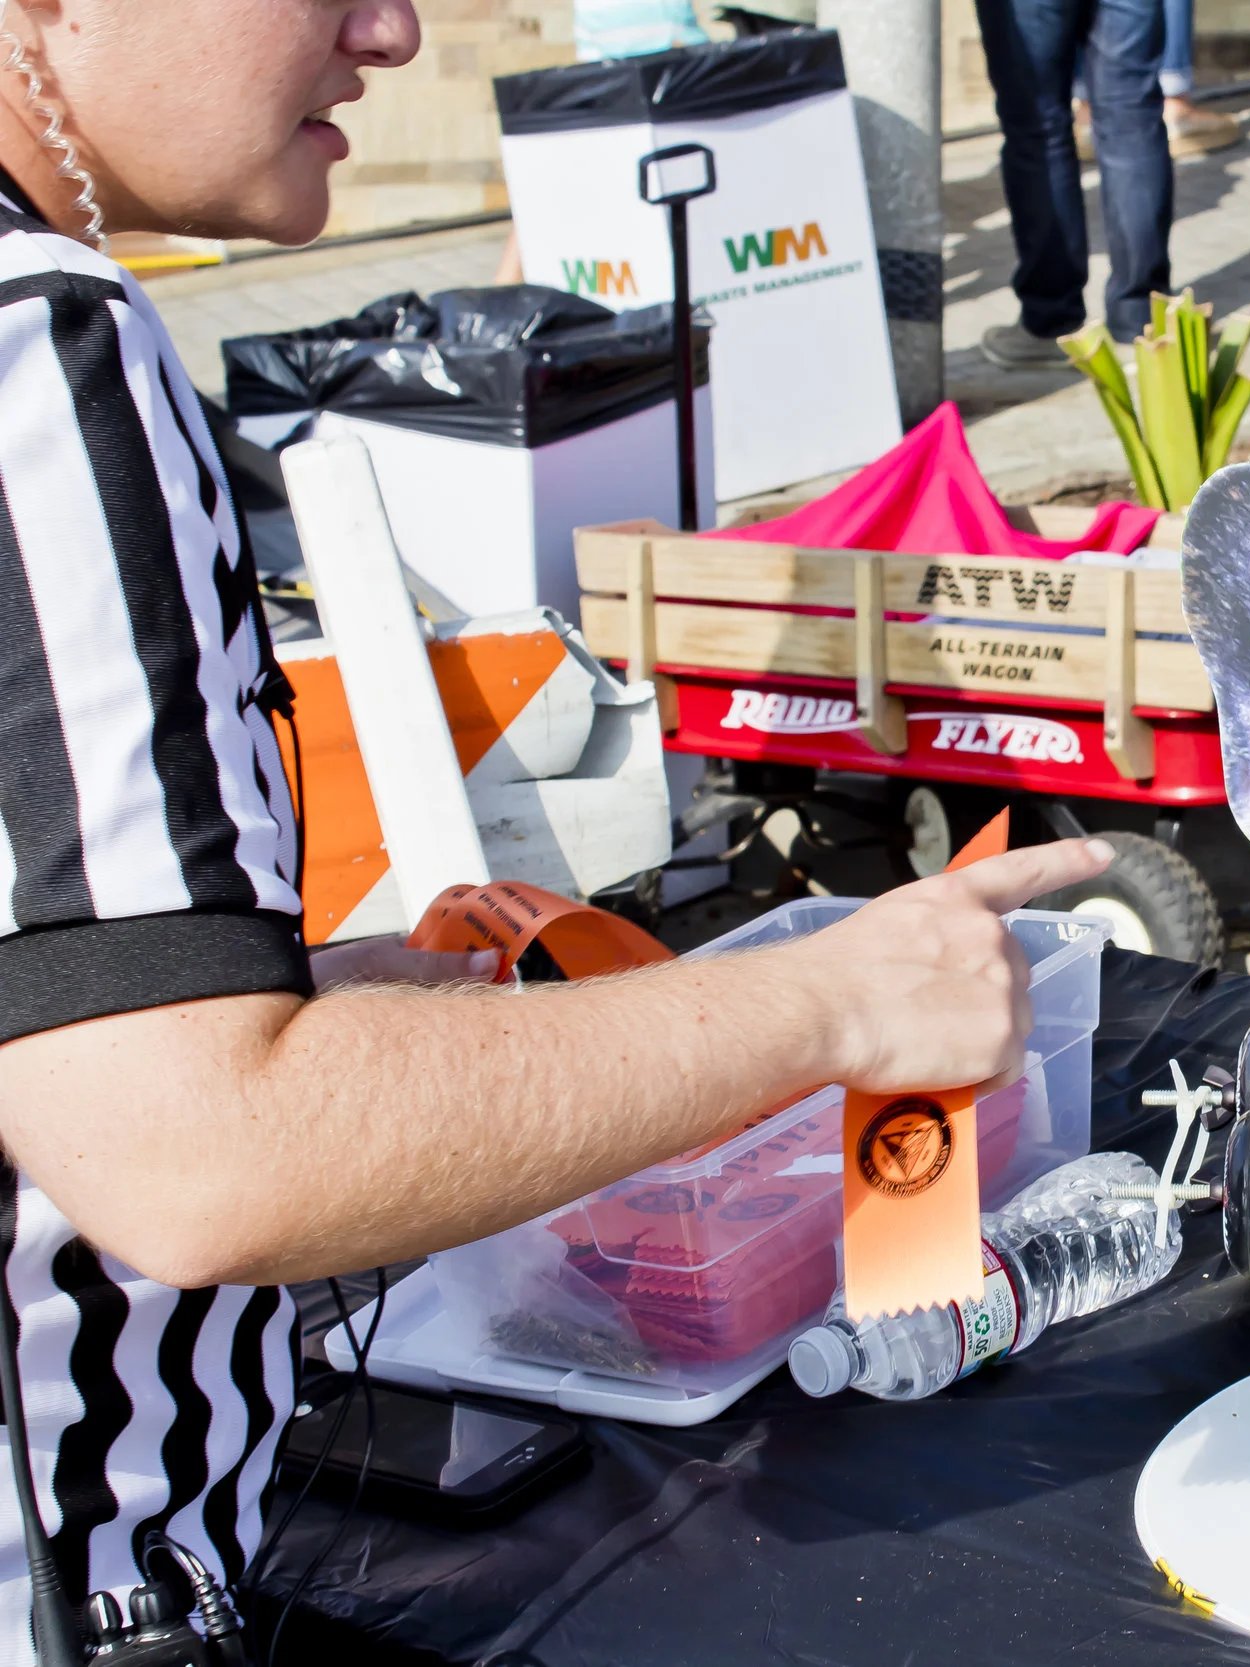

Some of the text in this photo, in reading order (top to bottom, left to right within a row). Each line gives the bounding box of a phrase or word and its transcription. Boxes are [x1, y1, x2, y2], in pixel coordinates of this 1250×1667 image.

[722, 220, 829, 274] WM
[561, 259, 639, 296] WM
[753, 260, 864, 294] MANAGEMENT
[916, 564, 1076, 612] ATW
[929, 638, 1065, 661] ALL-TERRAIN
[962, 663, 1035, 681] WAGON
